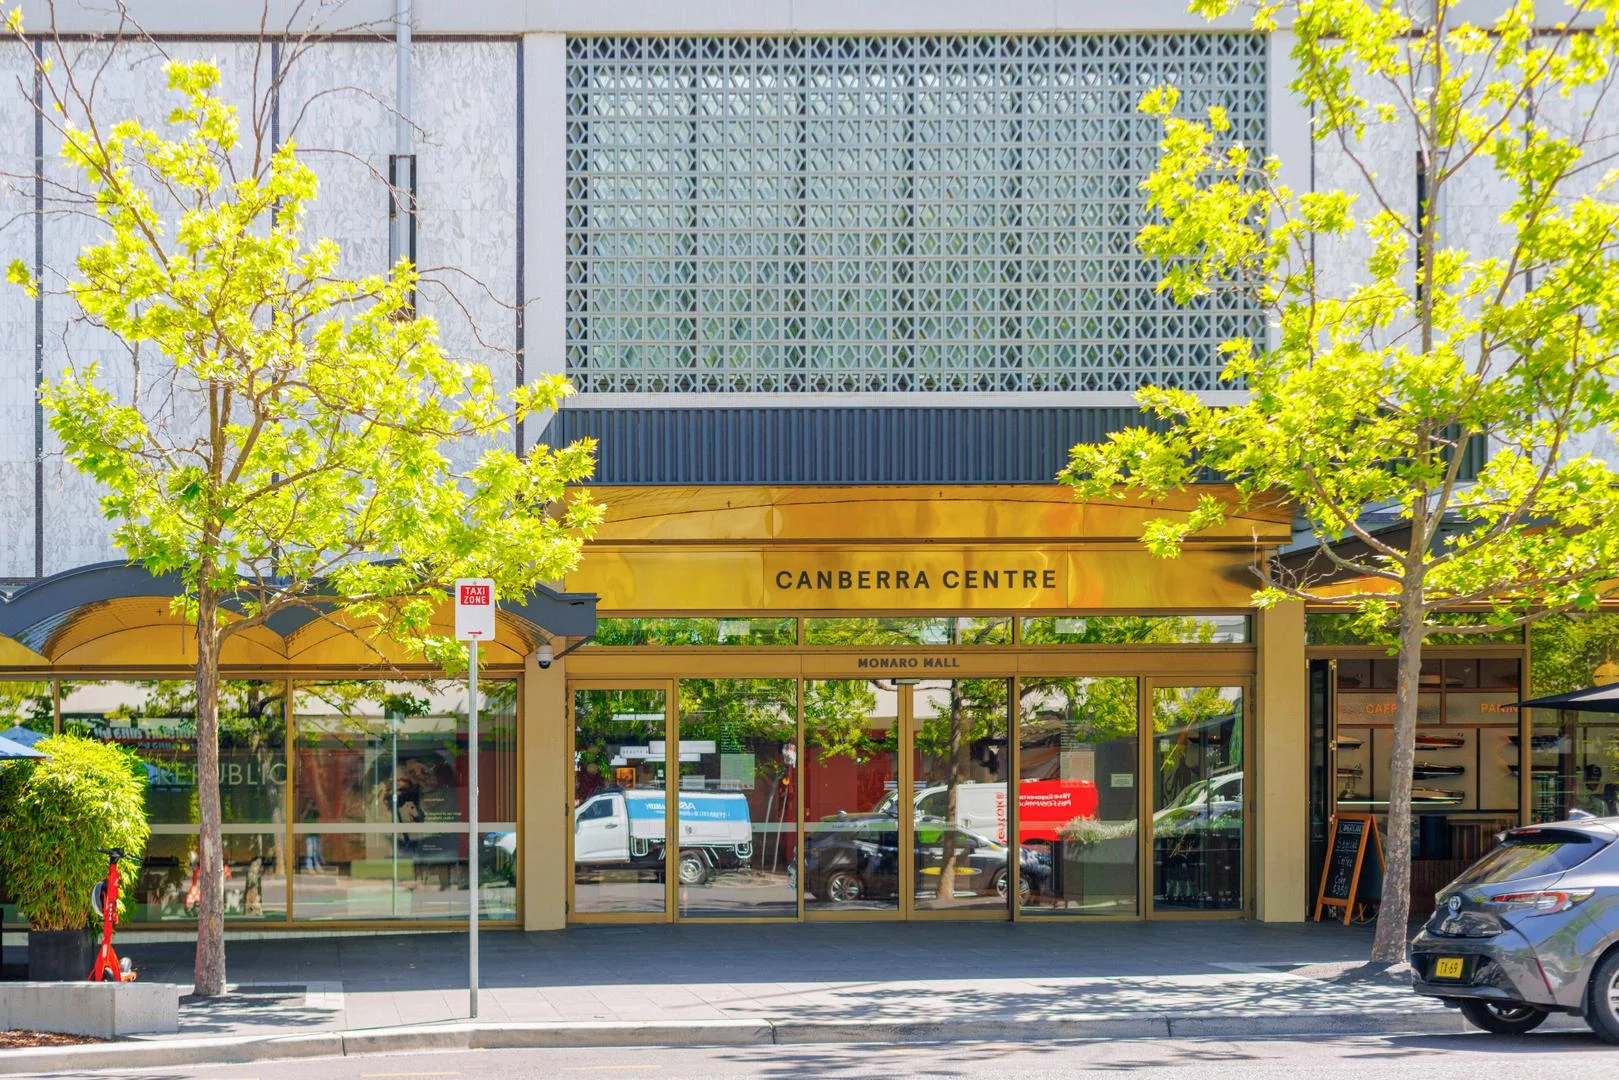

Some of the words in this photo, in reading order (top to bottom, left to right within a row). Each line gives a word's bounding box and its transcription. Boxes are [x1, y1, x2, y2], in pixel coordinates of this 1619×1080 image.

[776, 570, 930, 589] CANBERRA
[943, 570, 1056, 589] CENTRE
[465, 587, 485, 595] TAXI
[464, 595, 486, 604] ZONE
[858, 657, 918, 668] MONARO
[924, 657, 960, 668] MALL
[1365, 703, 1397, 714] CAFF
